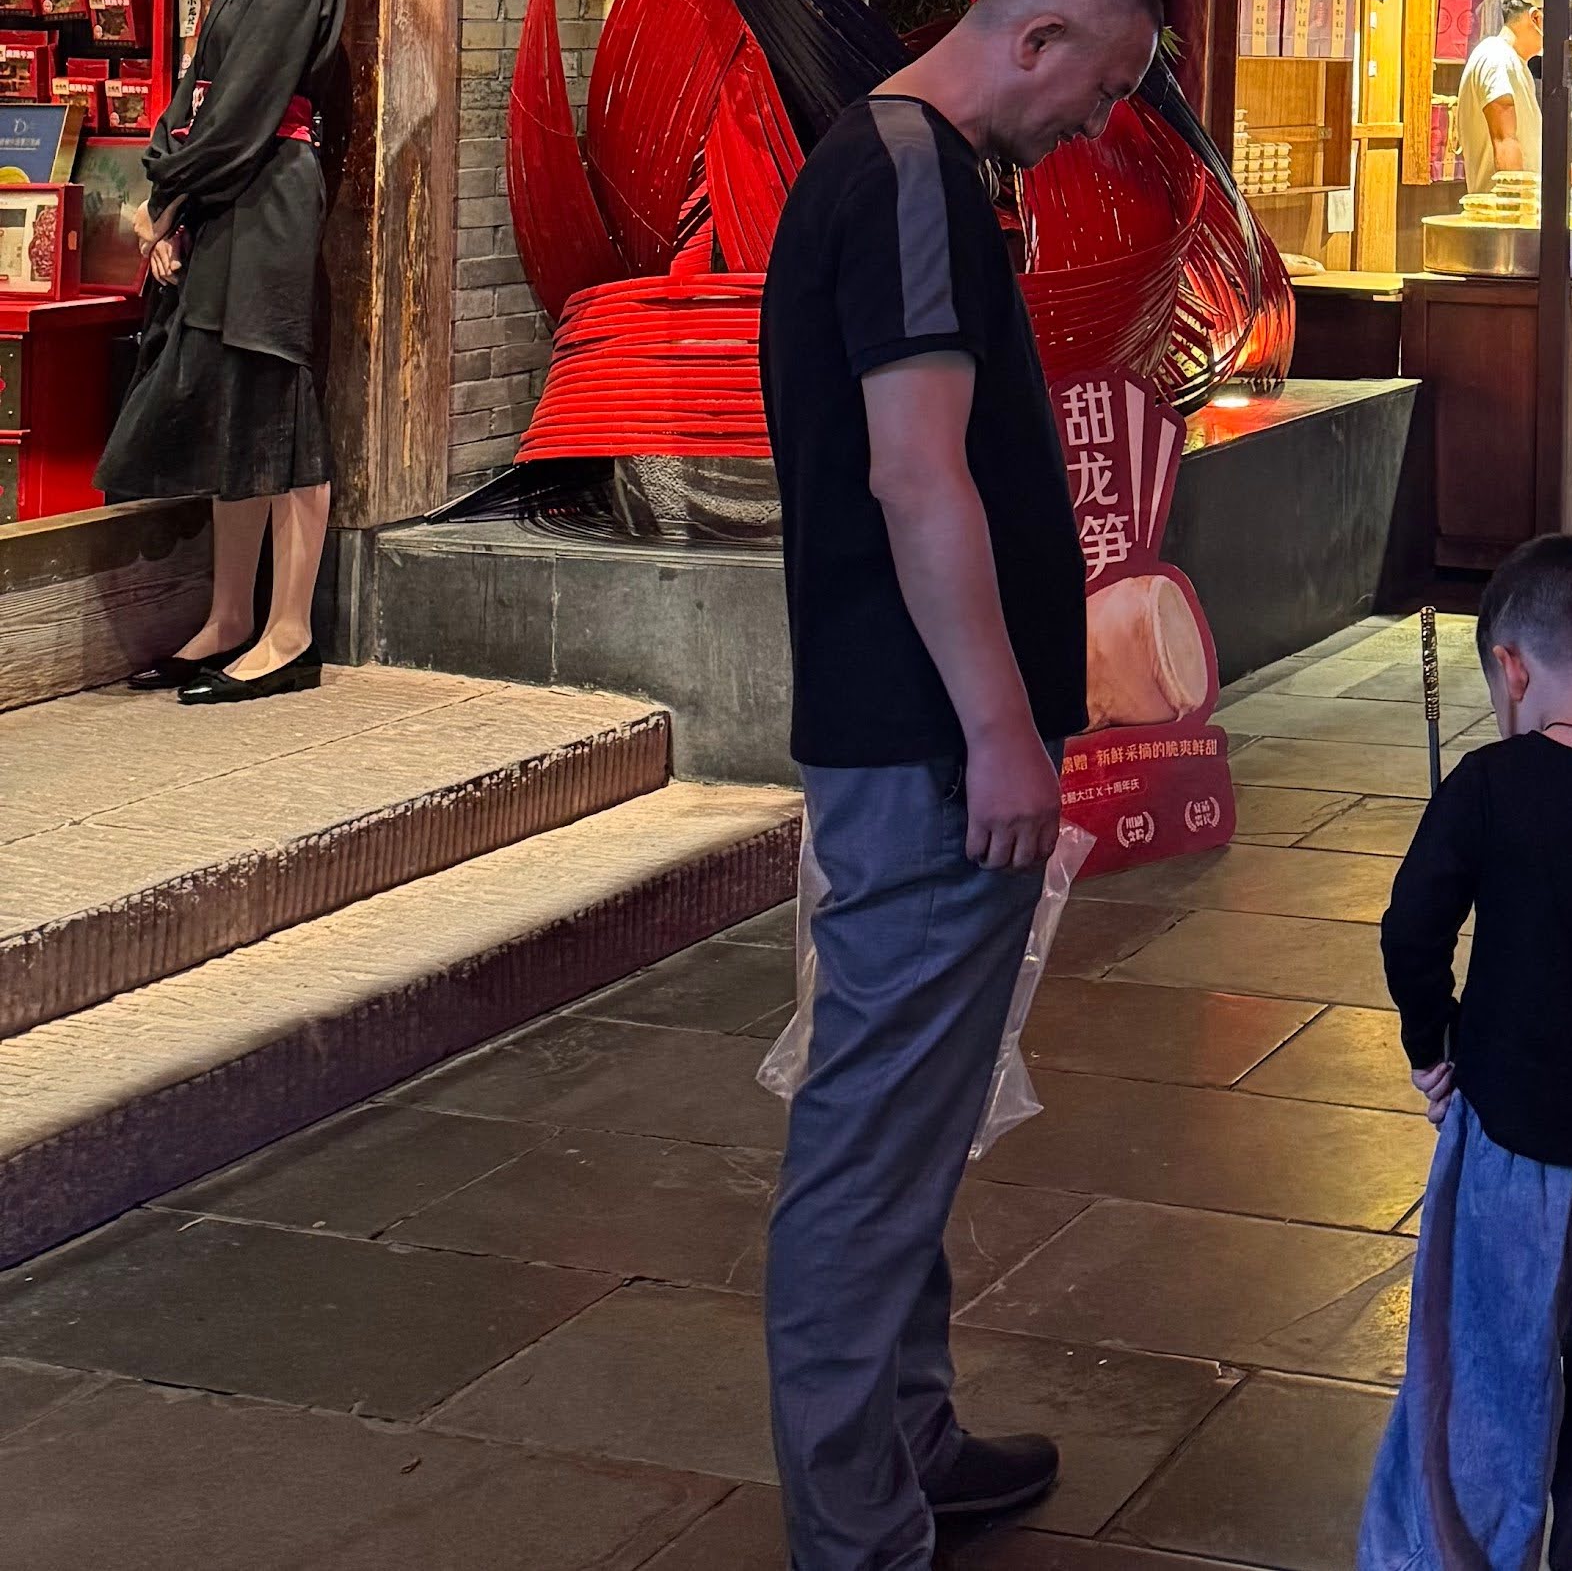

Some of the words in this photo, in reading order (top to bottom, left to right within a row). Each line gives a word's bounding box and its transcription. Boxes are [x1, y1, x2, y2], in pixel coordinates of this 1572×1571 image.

[1063, 380, 1132, 582] 甜龙笋
[1097, 738, 1217, 767] 新鲜采摘的脆爽鲜甜
